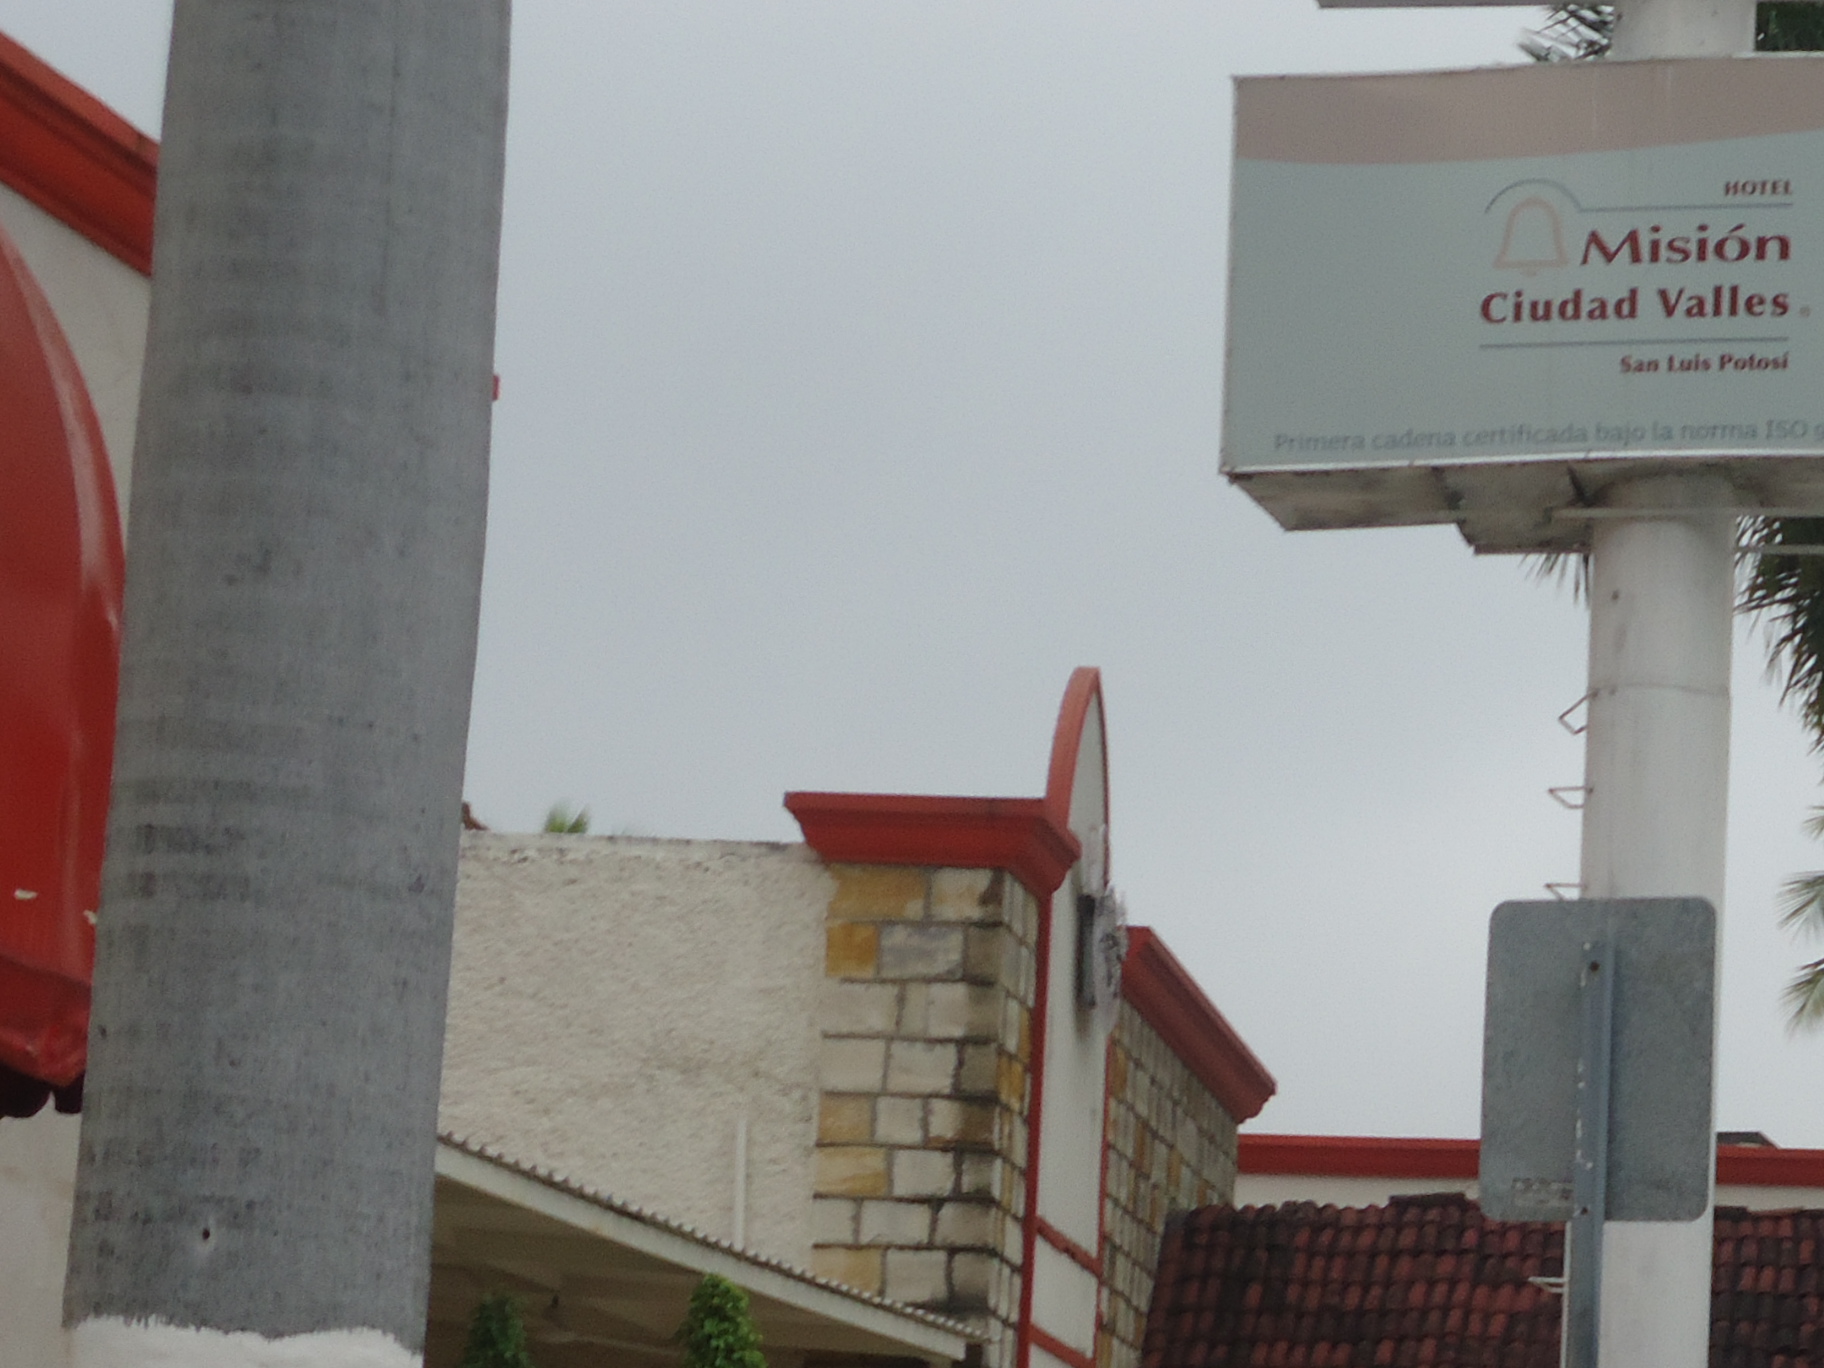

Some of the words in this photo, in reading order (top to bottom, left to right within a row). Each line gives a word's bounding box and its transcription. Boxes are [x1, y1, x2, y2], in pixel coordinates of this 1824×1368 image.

[1724, 180, 1793, 197] HOTEL
[1580, 223, 1791, 266] Misión
[1480, 287, 1640, 323] Ciudad
[1658, 284, 1790, 318] Valles
[1619, 355, 1659, 373] San
[1666, 353, 1711, 371] Luis
[1718, 351, 1790, 370] Potosí
[1273, 433, 1366, 450] Primera
[1371, 427, 1456, 449] cadena
[1461, 422, 1588, 447] certificada
[1595, 419, 1646, 447] bajo
[1651, 419, 1674, 442] la
[1680, 423, 1759, 442] norma
[1764, 418, 1806, 441] ISO
